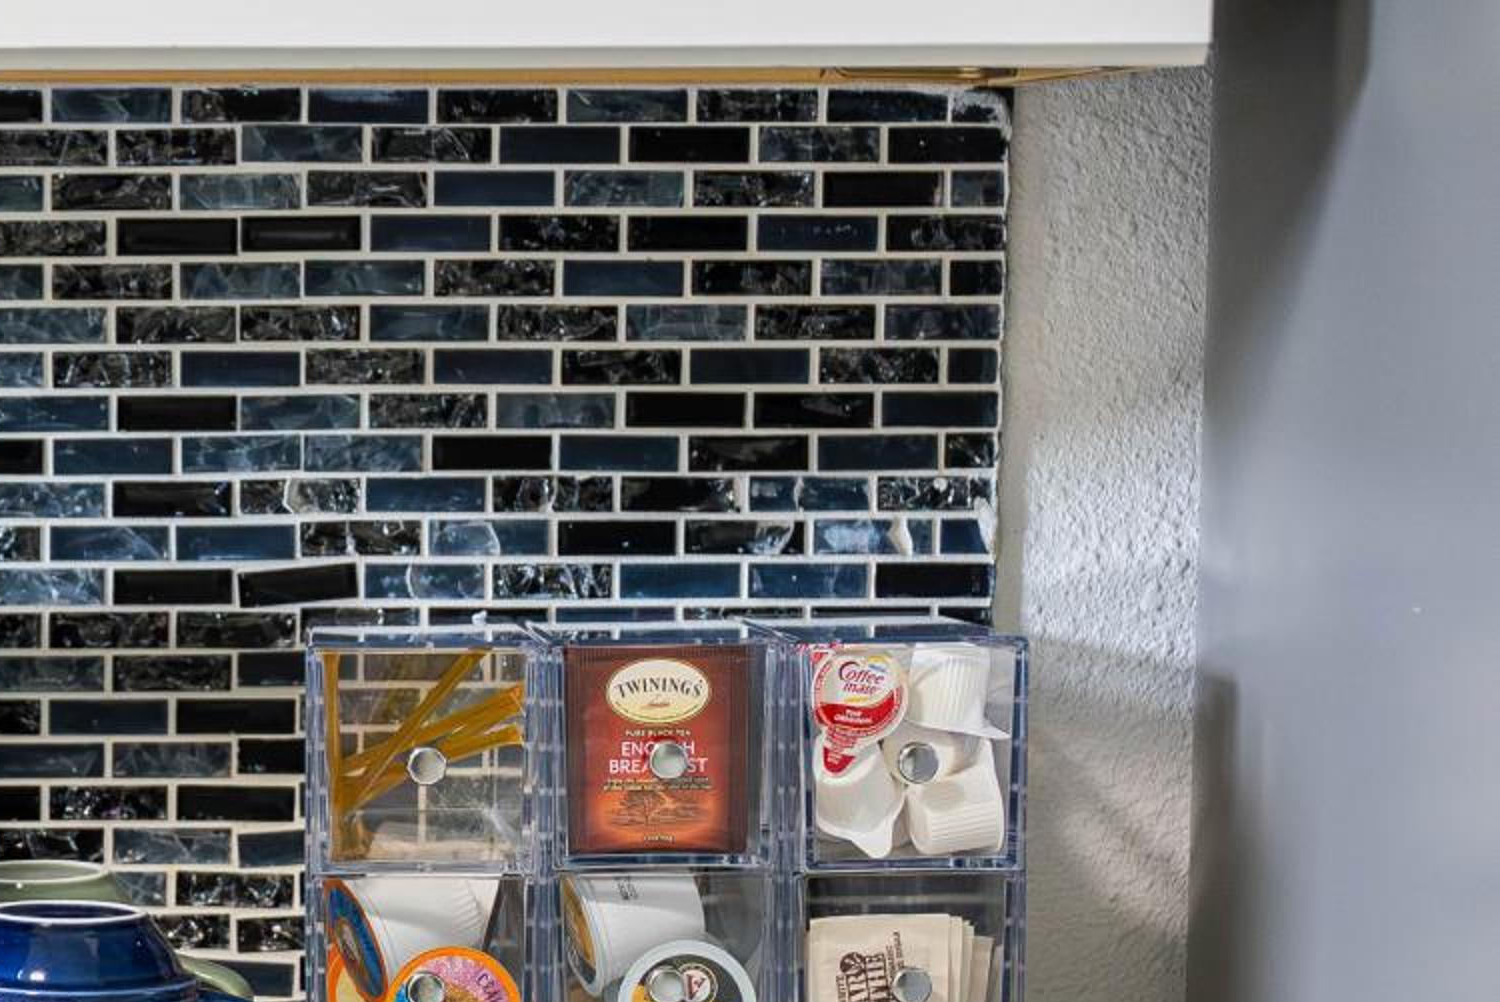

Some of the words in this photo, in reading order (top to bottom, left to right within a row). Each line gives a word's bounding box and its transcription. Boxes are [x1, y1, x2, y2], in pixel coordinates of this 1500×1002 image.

[839, 661, 885, 685] Coffee
[614, 677, 704, 699] TWININGS
[609, 757, 709, 773] BREST
[866, 953, 890, 1001] THE
